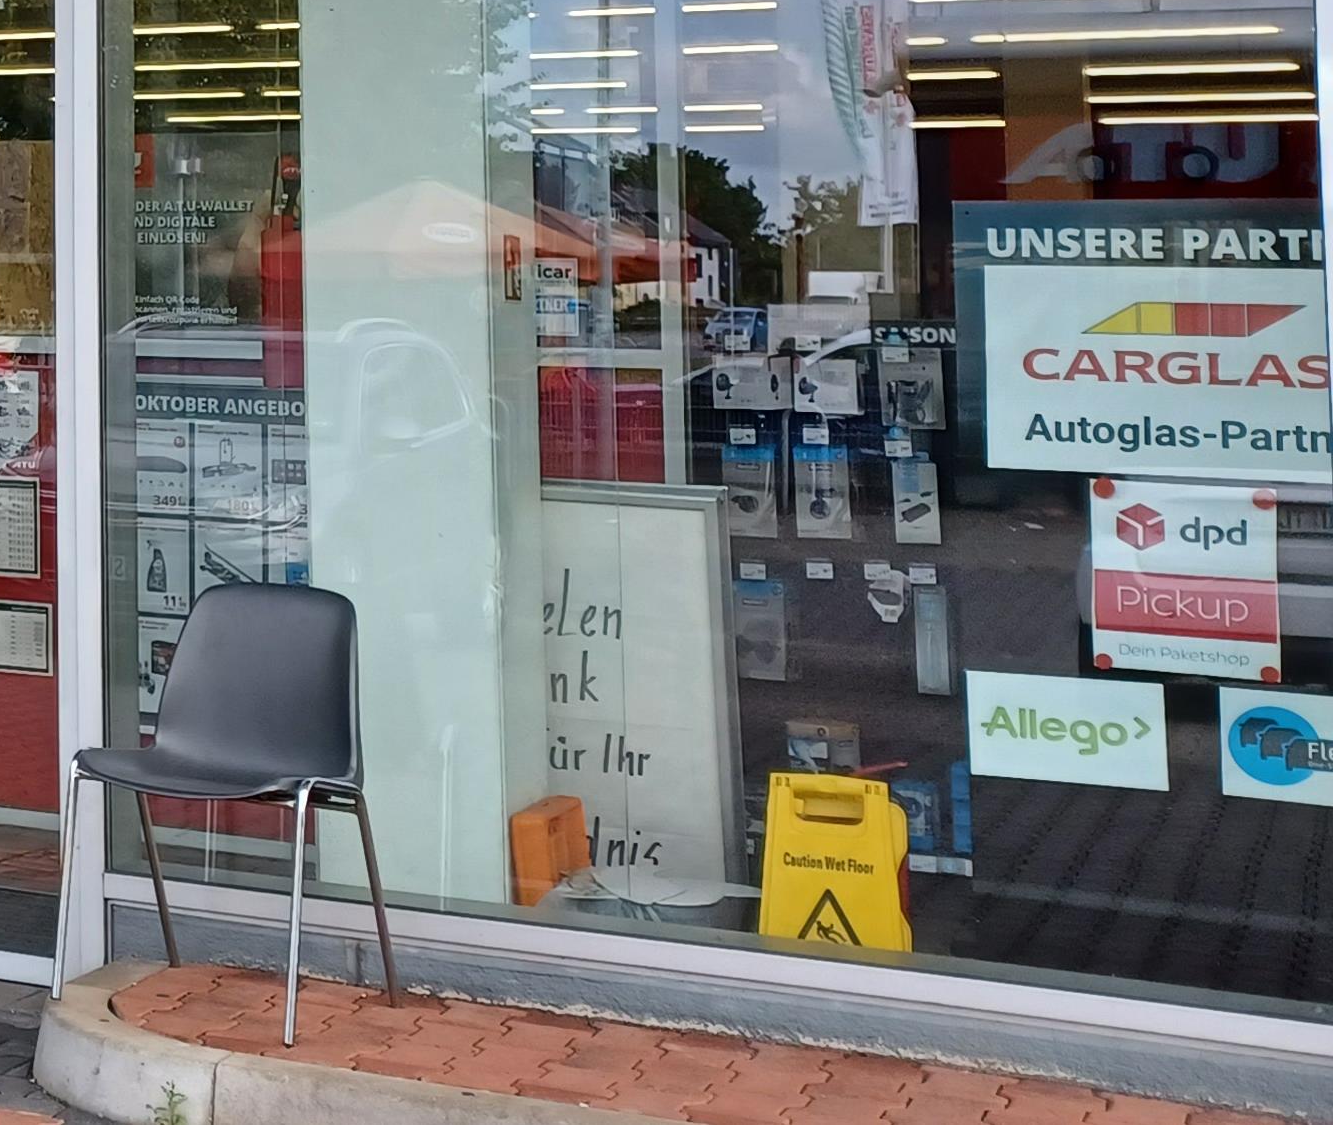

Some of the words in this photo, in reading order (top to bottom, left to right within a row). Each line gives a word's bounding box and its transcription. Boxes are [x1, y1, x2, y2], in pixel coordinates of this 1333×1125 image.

[135, 201, 160, 212] DER
[157, 216, 216, 228] DIGITALE
[986, 227, 1164, 260] UNSERE
[1022, 348, 1329, 389] CARGLAS
[135, 395, 220, 414] OKTOBER
[224, 398, 305, 417] ANGEBO
[1025, 413, 1332, 453] Autoglas-Partn
[1179, 517, 1247, 550] dpd
[1117, 586, 1249, 627] Pickup
[1118, 643, 1156, 658] Dein
[1161, 646, 1250, 667] Paketshop
[981, 706, 1128, 756] Allego
[547, 727, 587, 771] ür
[602, 733, 651, 777] Ihr
[783, 852, 823, 869] Caution
[825, 856, 845, 872] Wet
[847, 859, 874, 875] Floor
